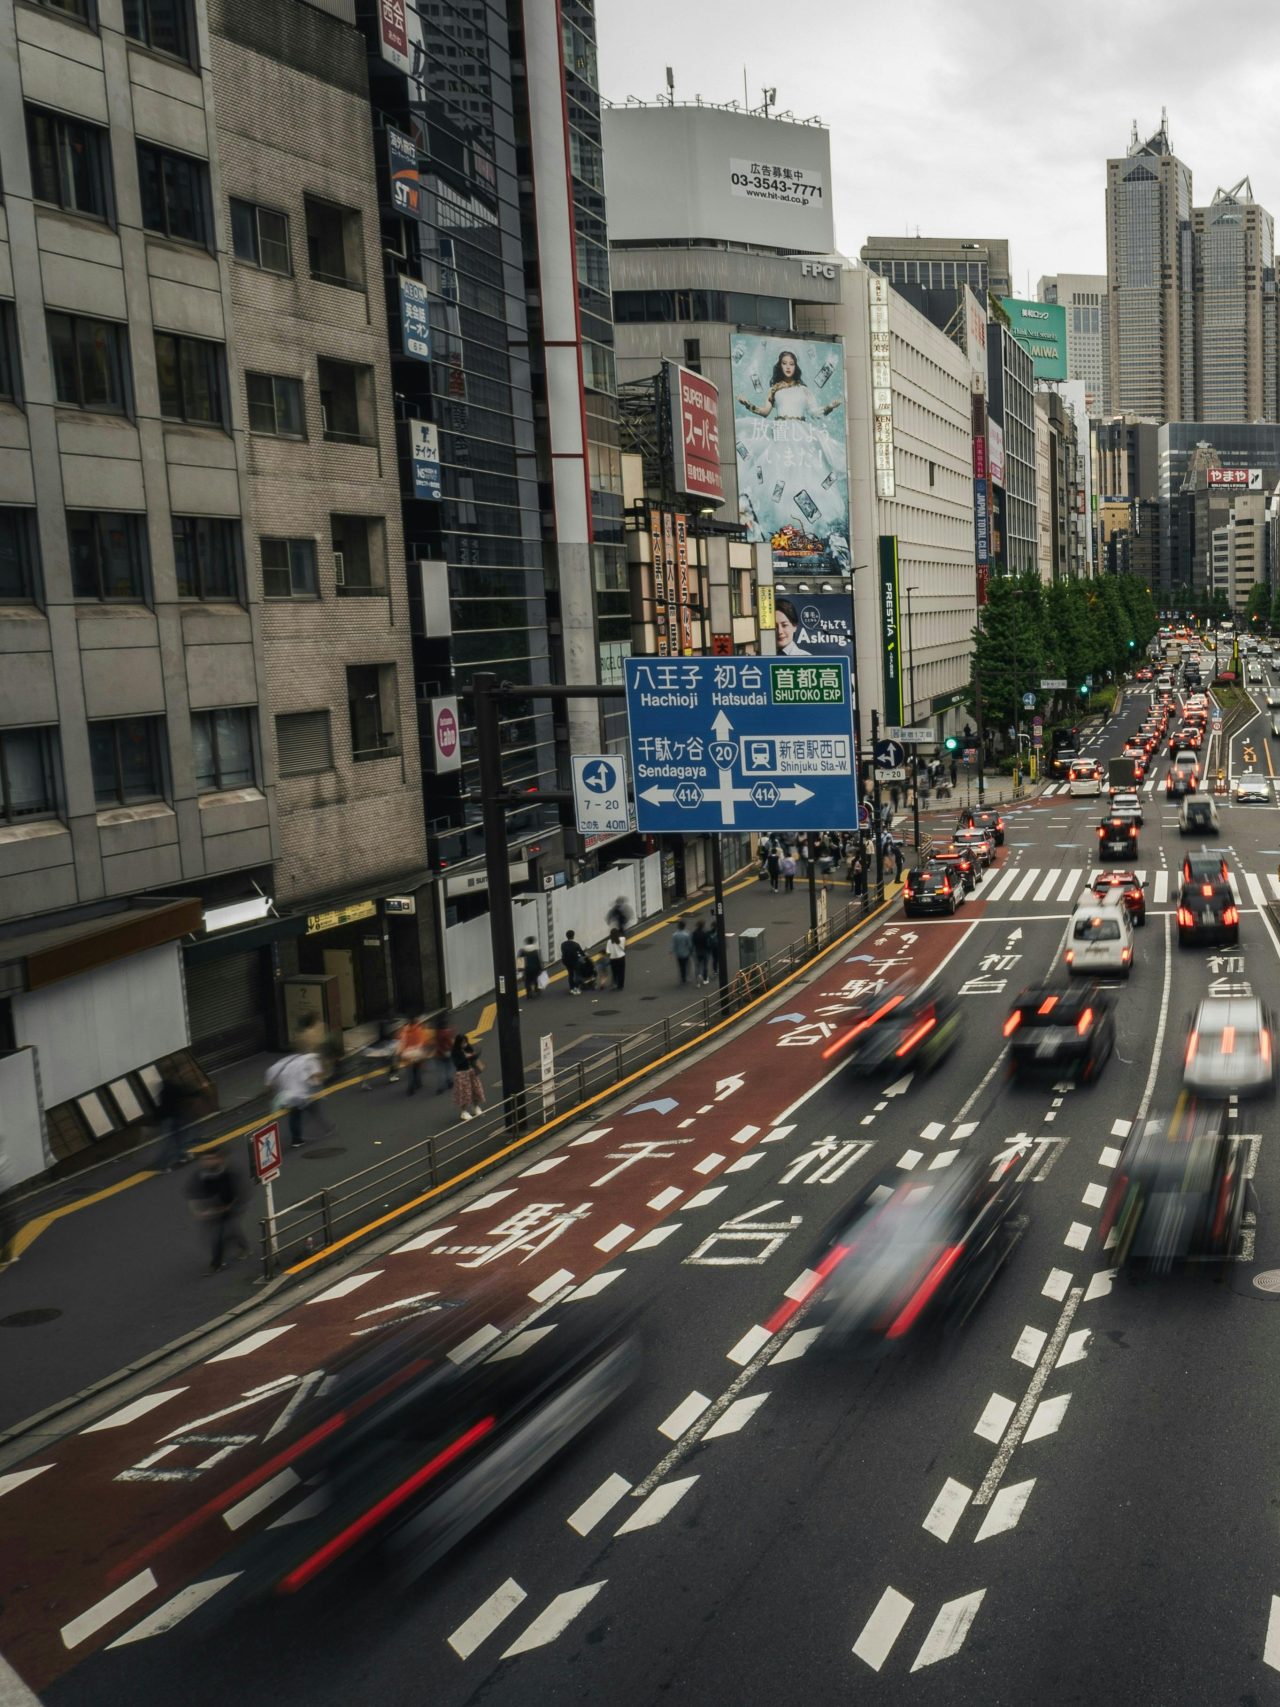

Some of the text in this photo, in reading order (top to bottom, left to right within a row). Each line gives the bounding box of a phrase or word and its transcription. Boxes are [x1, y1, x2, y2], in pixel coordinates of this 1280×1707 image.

[751, 163, 804, 181] 広告募集中
[731, 173, 823, 198] 03-3543-7771
[395, 180, 420, 214] STW
[746, 188, 810, 205] www.hit-ad.co.jp
[802, 262, 835, 279] FPG
[404, 281, 427, 302] AEON
[405, 302, 426, 323] 英会話
[404, 319, 429, 339] イーオン
[1031, 345, 1058, 359] MIWA
[683, 385, 703, 411] SUPER
[415, 444, 437, 460] テイケイ
[1211, 470, 1246, 482] やまや
[976, 493, 986, 518] JAPAN
[977, 518, 987, 540] TOTAL
[978, 540, 987, 560] CLUB
[820, 619, 848, 632] なんでも
[796, 627, 852, 647] Asking!
[633, 664, 762, 690] 八王子 初台
[775, 668, 839, 689] 首都高
[640, 692, 767, 709] Hachioji Hatsudai
[775, 689, 841, 701] SHUTOKO EXP
[440, 727, 456, 747] Labo
[715, 747, 732, 761] 20
[779, 740, 847, 760] 新宿駅西口
[638, 764, 707, 779] Sendagaya
[780, 759, 818, 774] Shinjuku
[678, 788, 699, 801] 414
[754, 788, 775, 800] 414
[580, 819, 627, 830] この先 40m
[958, 953, 1023, 995] 初台
[1207, 954, 1253, 998] 初台
[681, 1135, 879, 1267] 初台
